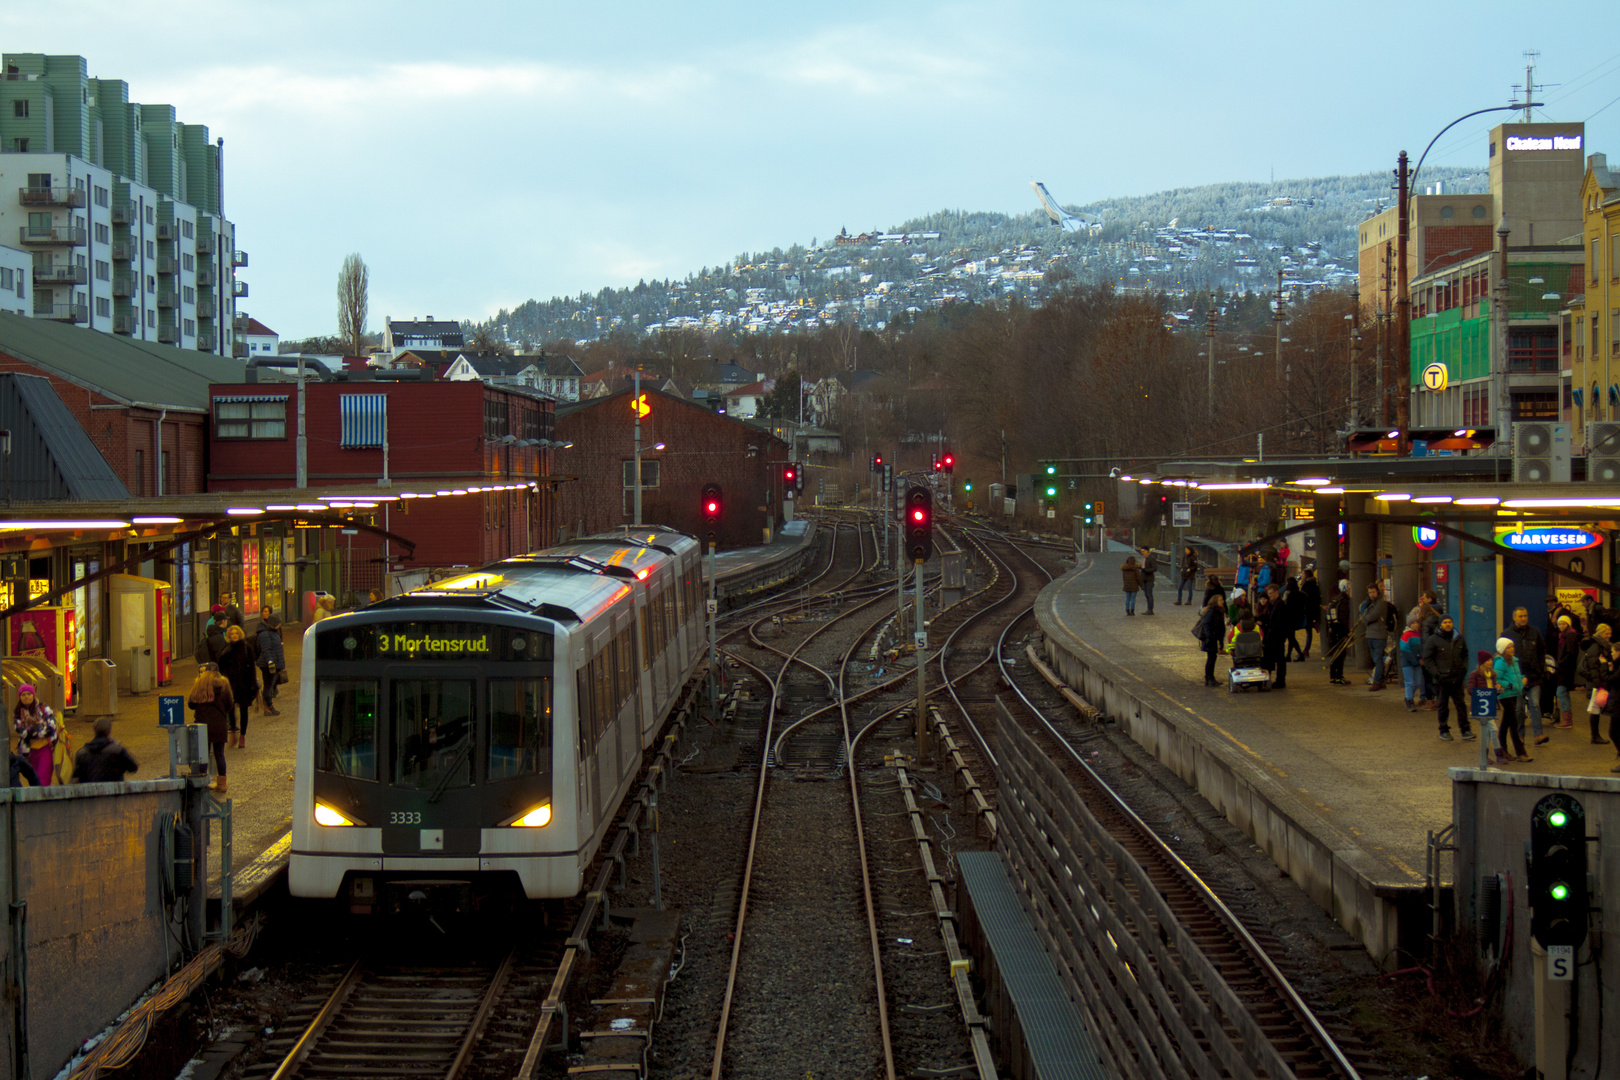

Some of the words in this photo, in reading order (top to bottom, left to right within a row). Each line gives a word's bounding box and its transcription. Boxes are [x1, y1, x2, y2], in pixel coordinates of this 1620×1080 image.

[1429, 371, 1440, 387] T
[1510, 534, 1587, 545] NARVESEN
[10, 561, 17, 575] 1
[379, 634, 390, 652] 3
[917, 638, 925, 648] S
[1475, 689, 1493, 697] Spor
[163, 697, 180, 706] Spor
[1478, 698, 1490, 716] 3
[167, 707, 174, 724] 1
[390, 811, 422, 824] 3333
[1553, 958, 1567, 977] S
